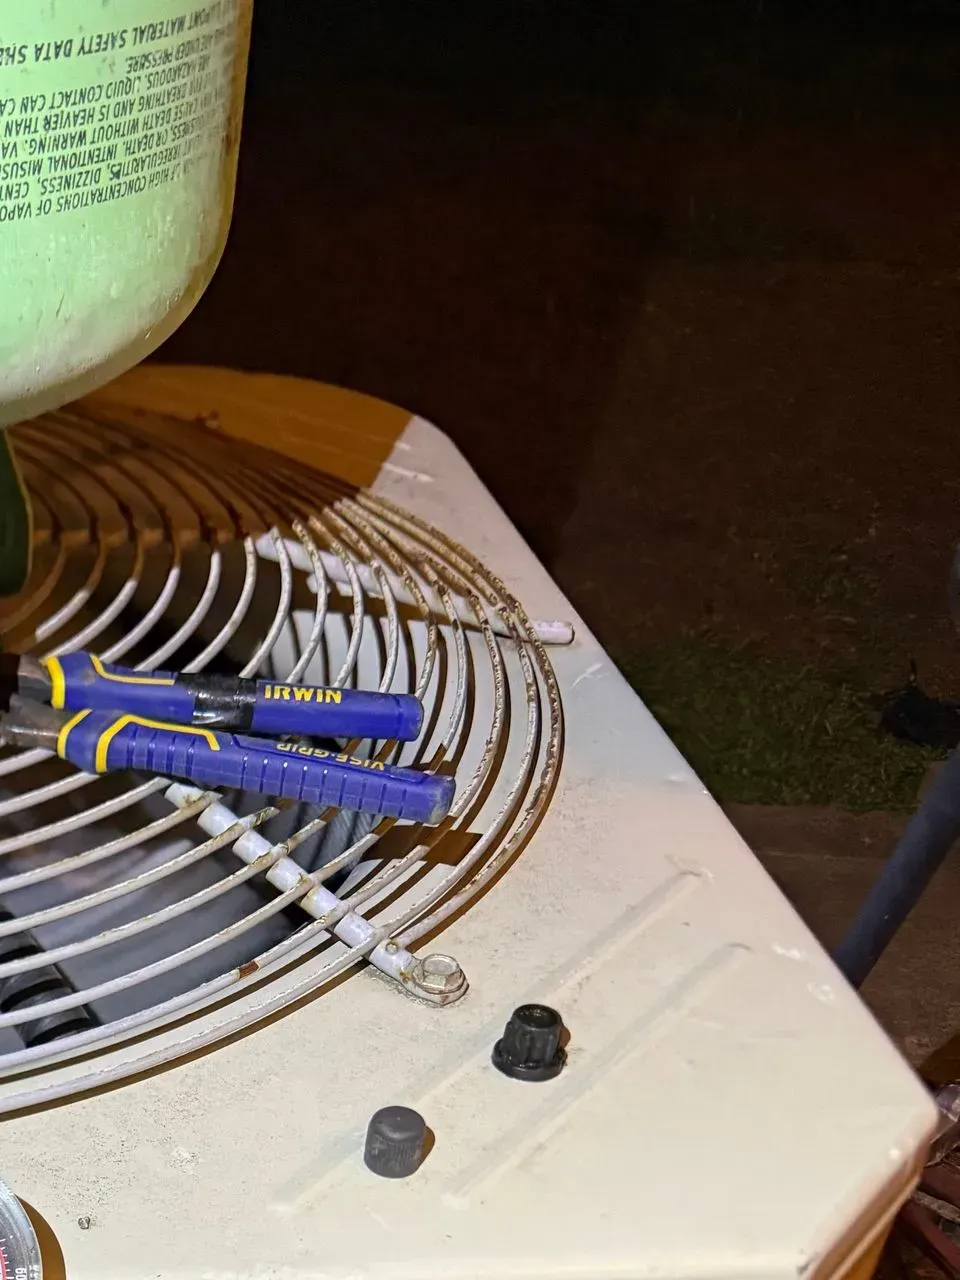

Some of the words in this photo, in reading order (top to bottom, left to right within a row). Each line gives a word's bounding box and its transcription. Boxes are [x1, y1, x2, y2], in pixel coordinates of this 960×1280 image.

[132, 14, 186, 43] MATERIAL
[34, 38, 74, 62] DATA
[78, 29, 128, 56] SAFETY
[20, 94, 46, 112] CAN
[48, 84, 103, 108] CONTACT
[114, 97, 136, 116] AND
[4, 117, 40, 138] THAN
[42, 107, 96, 132] HEAVIER
[90, 116, 140, 144] WITHOUT
[24, 130, 87, 156] WARNING.
[122, 130, 156, 156] DEATH.
[48, 144, 118, 174] INTENTIONAL
[106, 144, 181, 180] IRREGULARITIES,
[36, 166, 102, 196] DIZZINESS,
[56, 175, 146, 213] CONCENTRATIONS
[35, 198, 52, 216] OF
[264, 684, 342, 703] IRWIN
